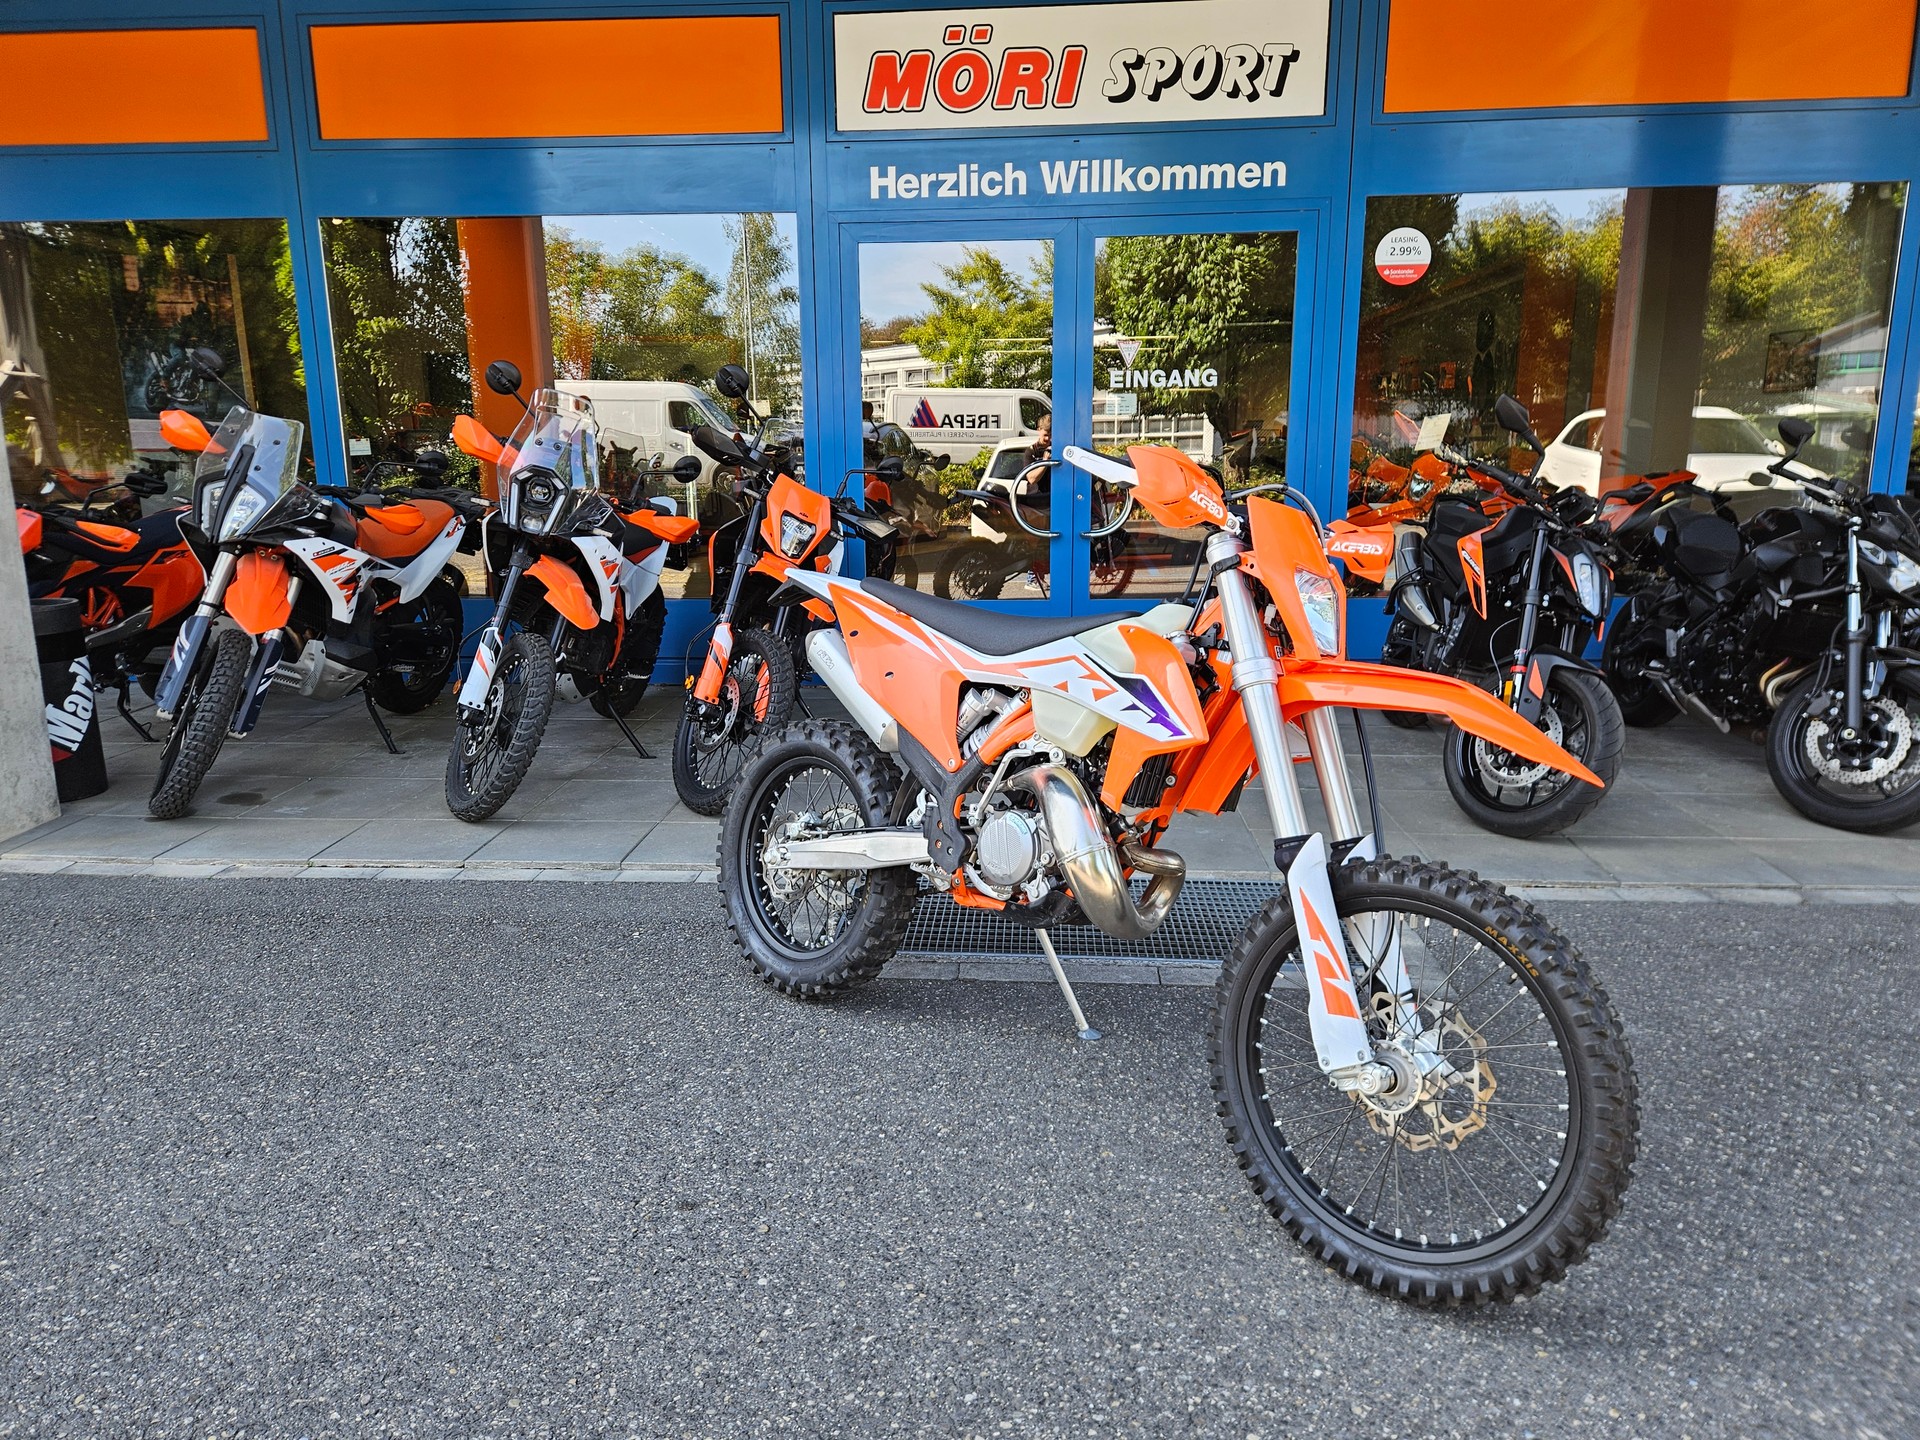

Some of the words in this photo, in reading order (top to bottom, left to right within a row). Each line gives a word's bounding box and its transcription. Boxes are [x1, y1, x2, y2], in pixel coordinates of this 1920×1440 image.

[863, 24, 1087, 114] MÖRI
[1102, 43, 1300, 103] SPORT
[869, 163, 1027, 200] Herzlich
[1040, 160, 1287, 194] Willkommen
[1390, 246, 1421, 256] 2.99%
[1110, 368, 1218, 388] EINGANG
[1484, 925, 1540, 977] MAXXIS
